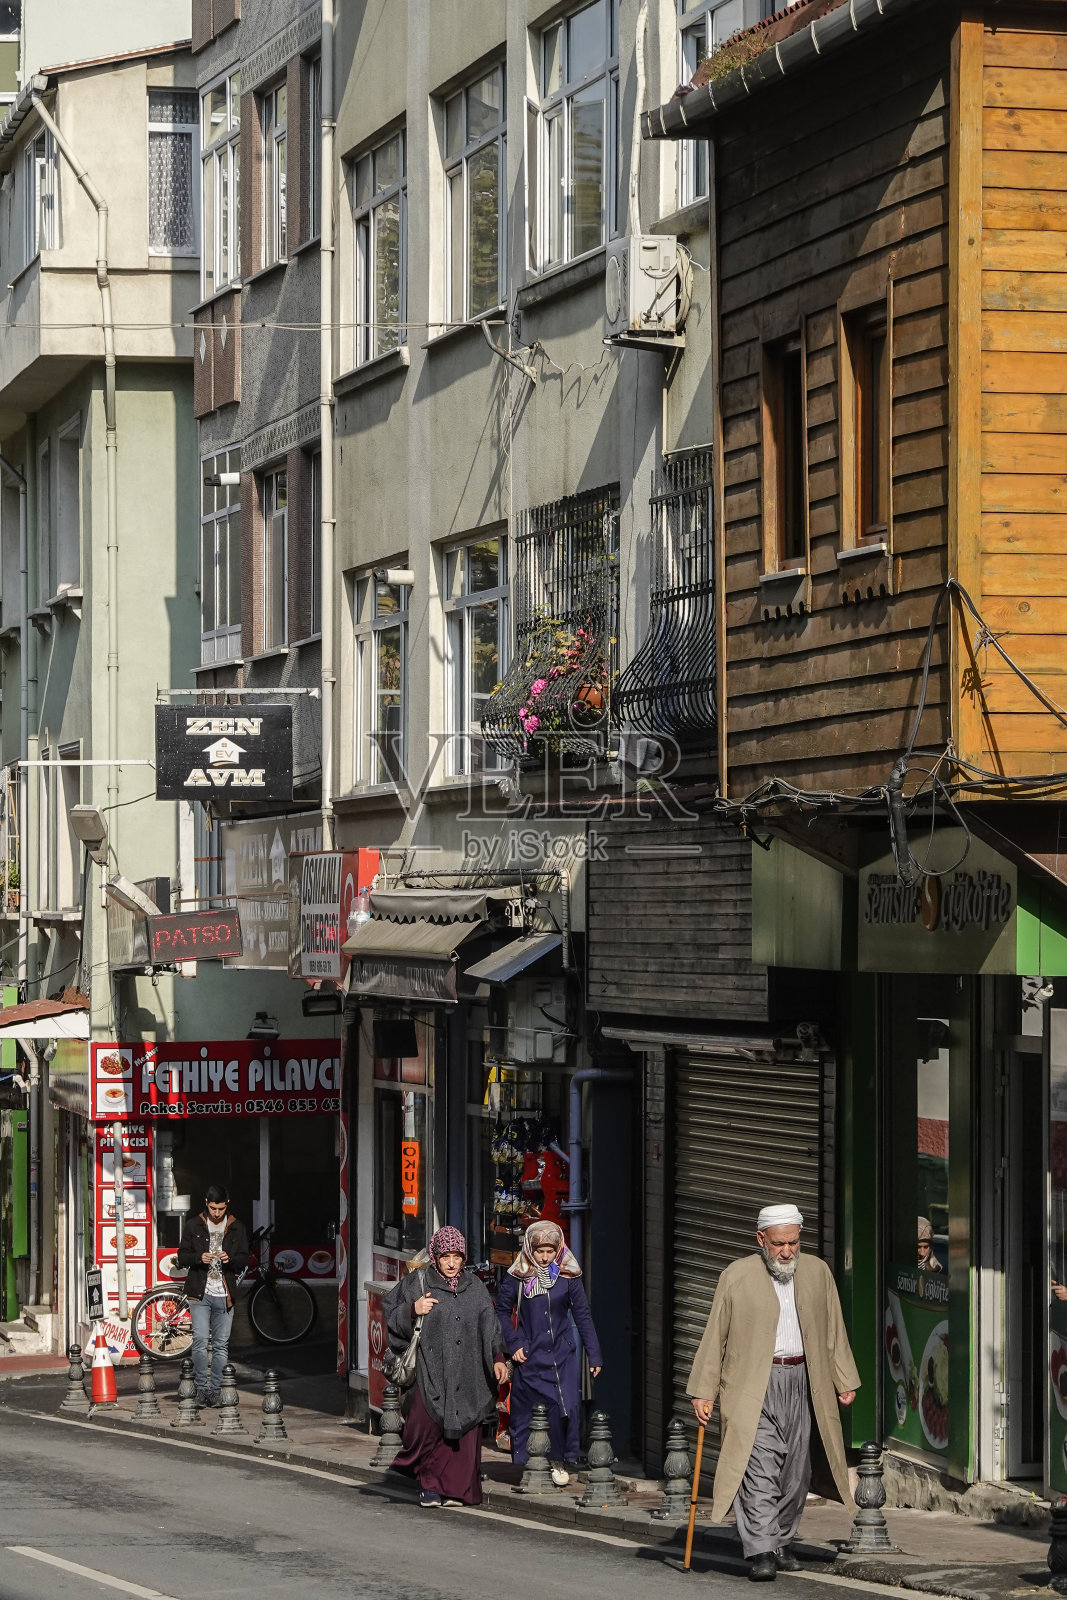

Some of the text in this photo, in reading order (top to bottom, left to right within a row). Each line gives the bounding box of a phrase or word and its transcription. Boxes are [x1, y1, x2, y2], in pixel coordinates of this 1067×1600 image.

[186, 718, 263, 735] ZEN
[215, 750, 234, 758] EV
[184, 769, 265, 786] AVM
[302, 856, 342, 905] OSMANLI
[155, 924, 231, 949] PATSO
[302, 913, 339, 954] DÖNERCİSİ
[141, 1046, 238, 1094] FETHİYE
[140, 1101, 184, 1114] Paket
[187, 1100, 232, 1114] Servis
[245, 1099, 284, 1113] 0546
[287, 1099, 317, 1112] 855
[100, 1135, 148, 1147] PİLVCISI
